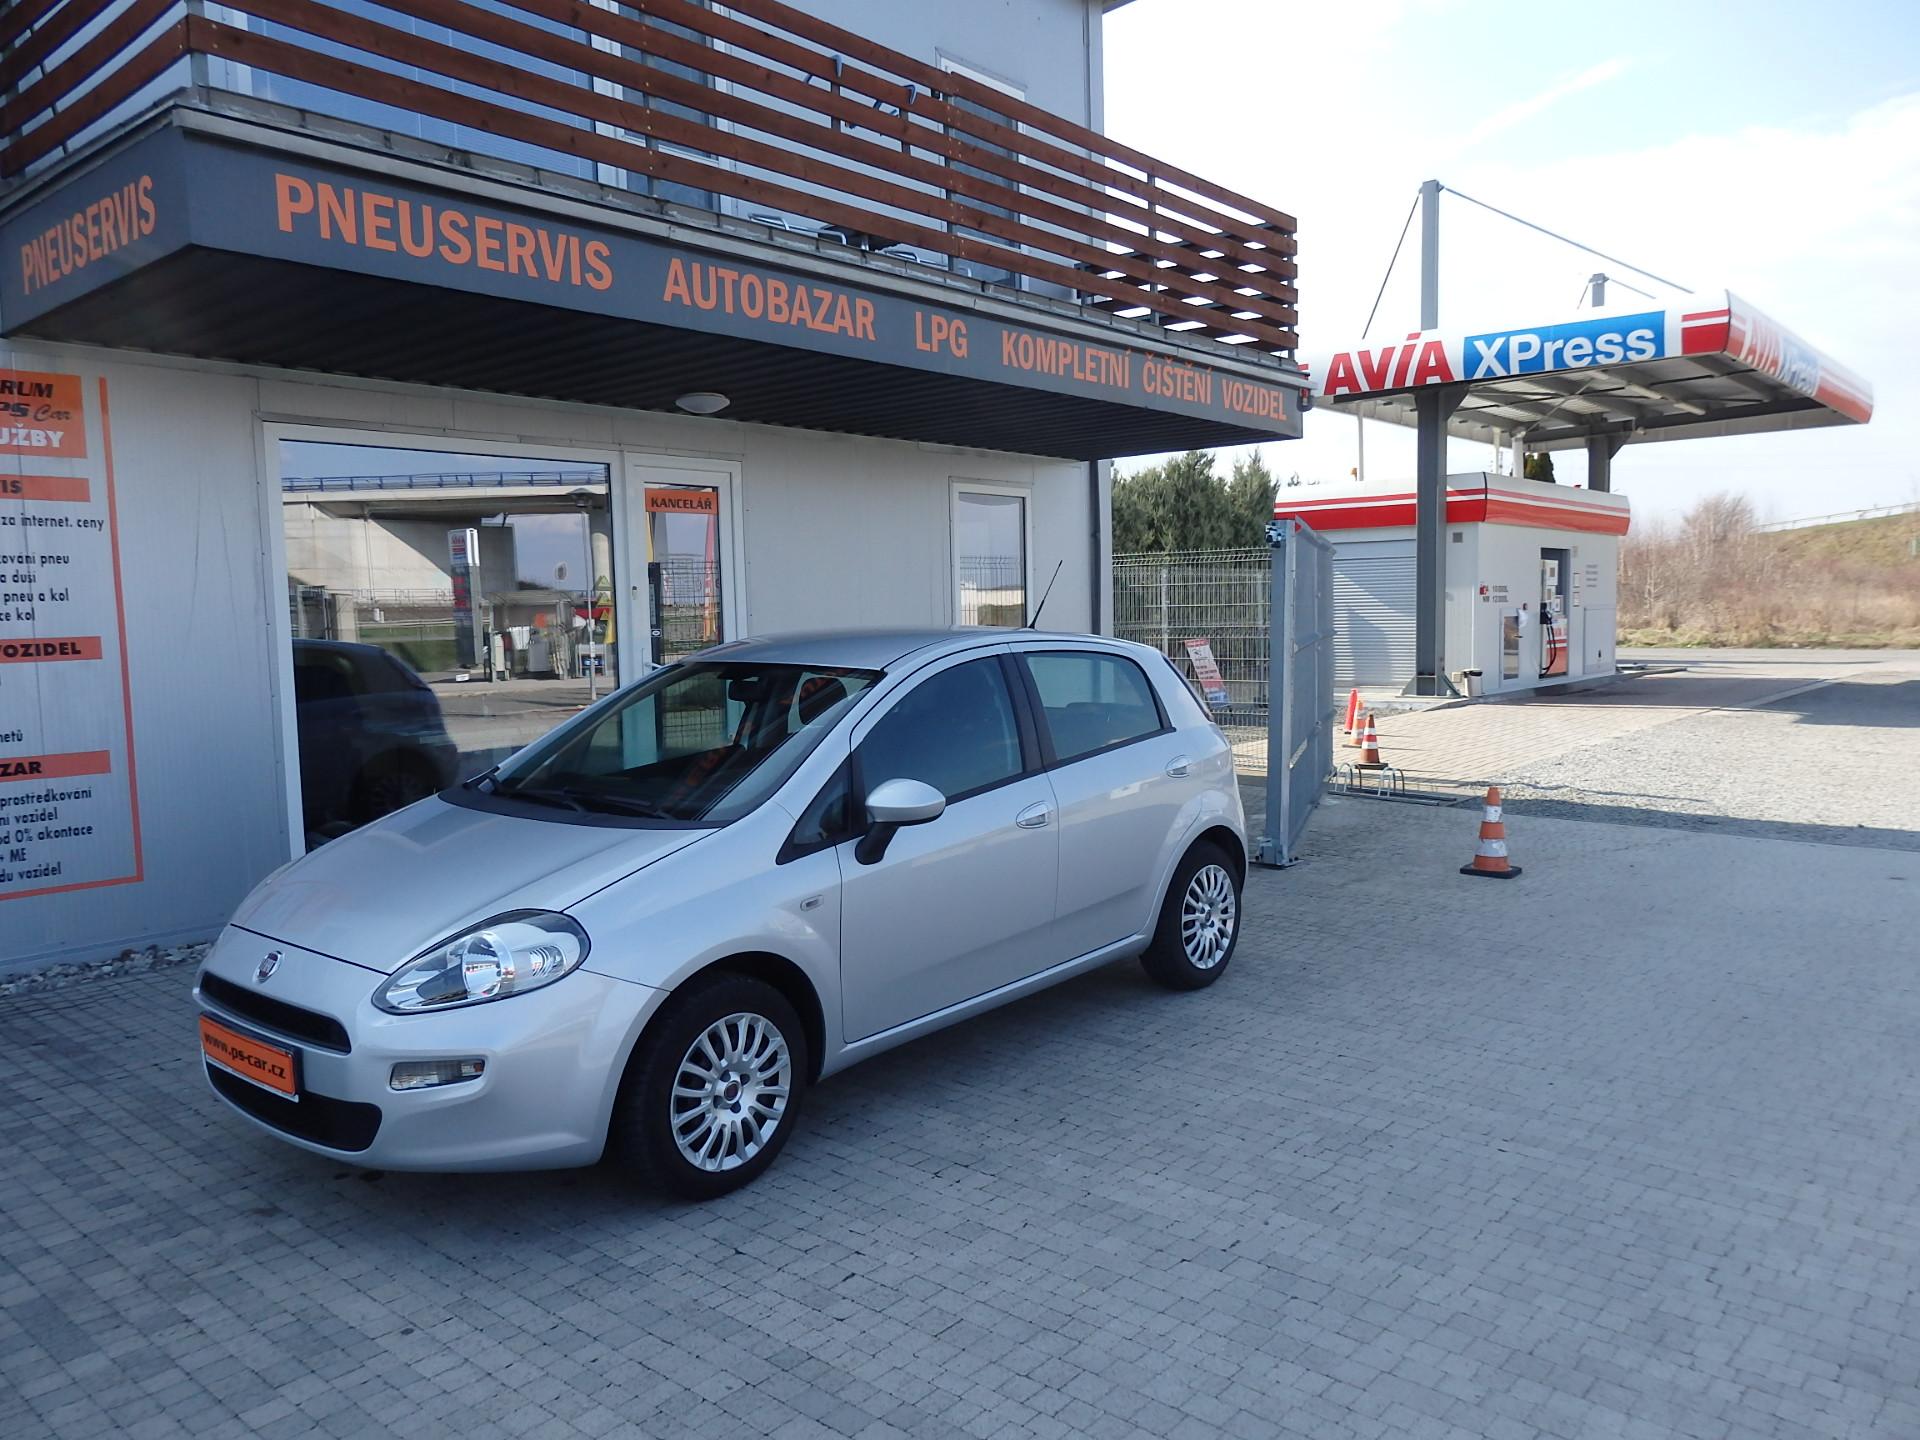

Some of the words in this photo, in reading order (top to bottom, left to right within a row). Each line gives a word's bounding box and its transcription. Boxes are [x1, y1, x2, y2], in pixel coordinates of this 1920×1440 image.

[20, 174, 156, 295] PNEUSERVIS
[274, 172, 614, 291] PNEUSERVIS
[663, 256, 876, 341] AUTOBAZAR
[914, 310, 968, 359] LPG
[1001, 329, 1130, 389] KOMPLETNÍ
[1142, 350, 1214, 406] ČIŠTĚNÍ
[1221, 378, 1288, 421] VOZIDEL
[1471, 327, 1654, 379] XPress
[33, 403, 72, 422] Car
[0, 479, 23, 495] IS
[650, 496, 713, 510] KANCELÁŘ
[0, 516, 16, 526] za
[20, 512, 73, 528] internet.
[76, 519, 105, 533] ceny
[0, 552, 36, 565] ování
[40, 555, 70, 568] pneu
[3, 592, 34, 606] pneu
[38, 592, 46, 602] a
[50, 587, 70, 602] kol
[15, 606, 35, 621] kol
[14, 807, 58, 824] vozidel
[15, 828, 33, 843] 0%
[37, 825, 94, 841] akontace
[18, 861, 62, 880] vozidel
[203, 1031, 287, 1080] www.ps-car.cz
